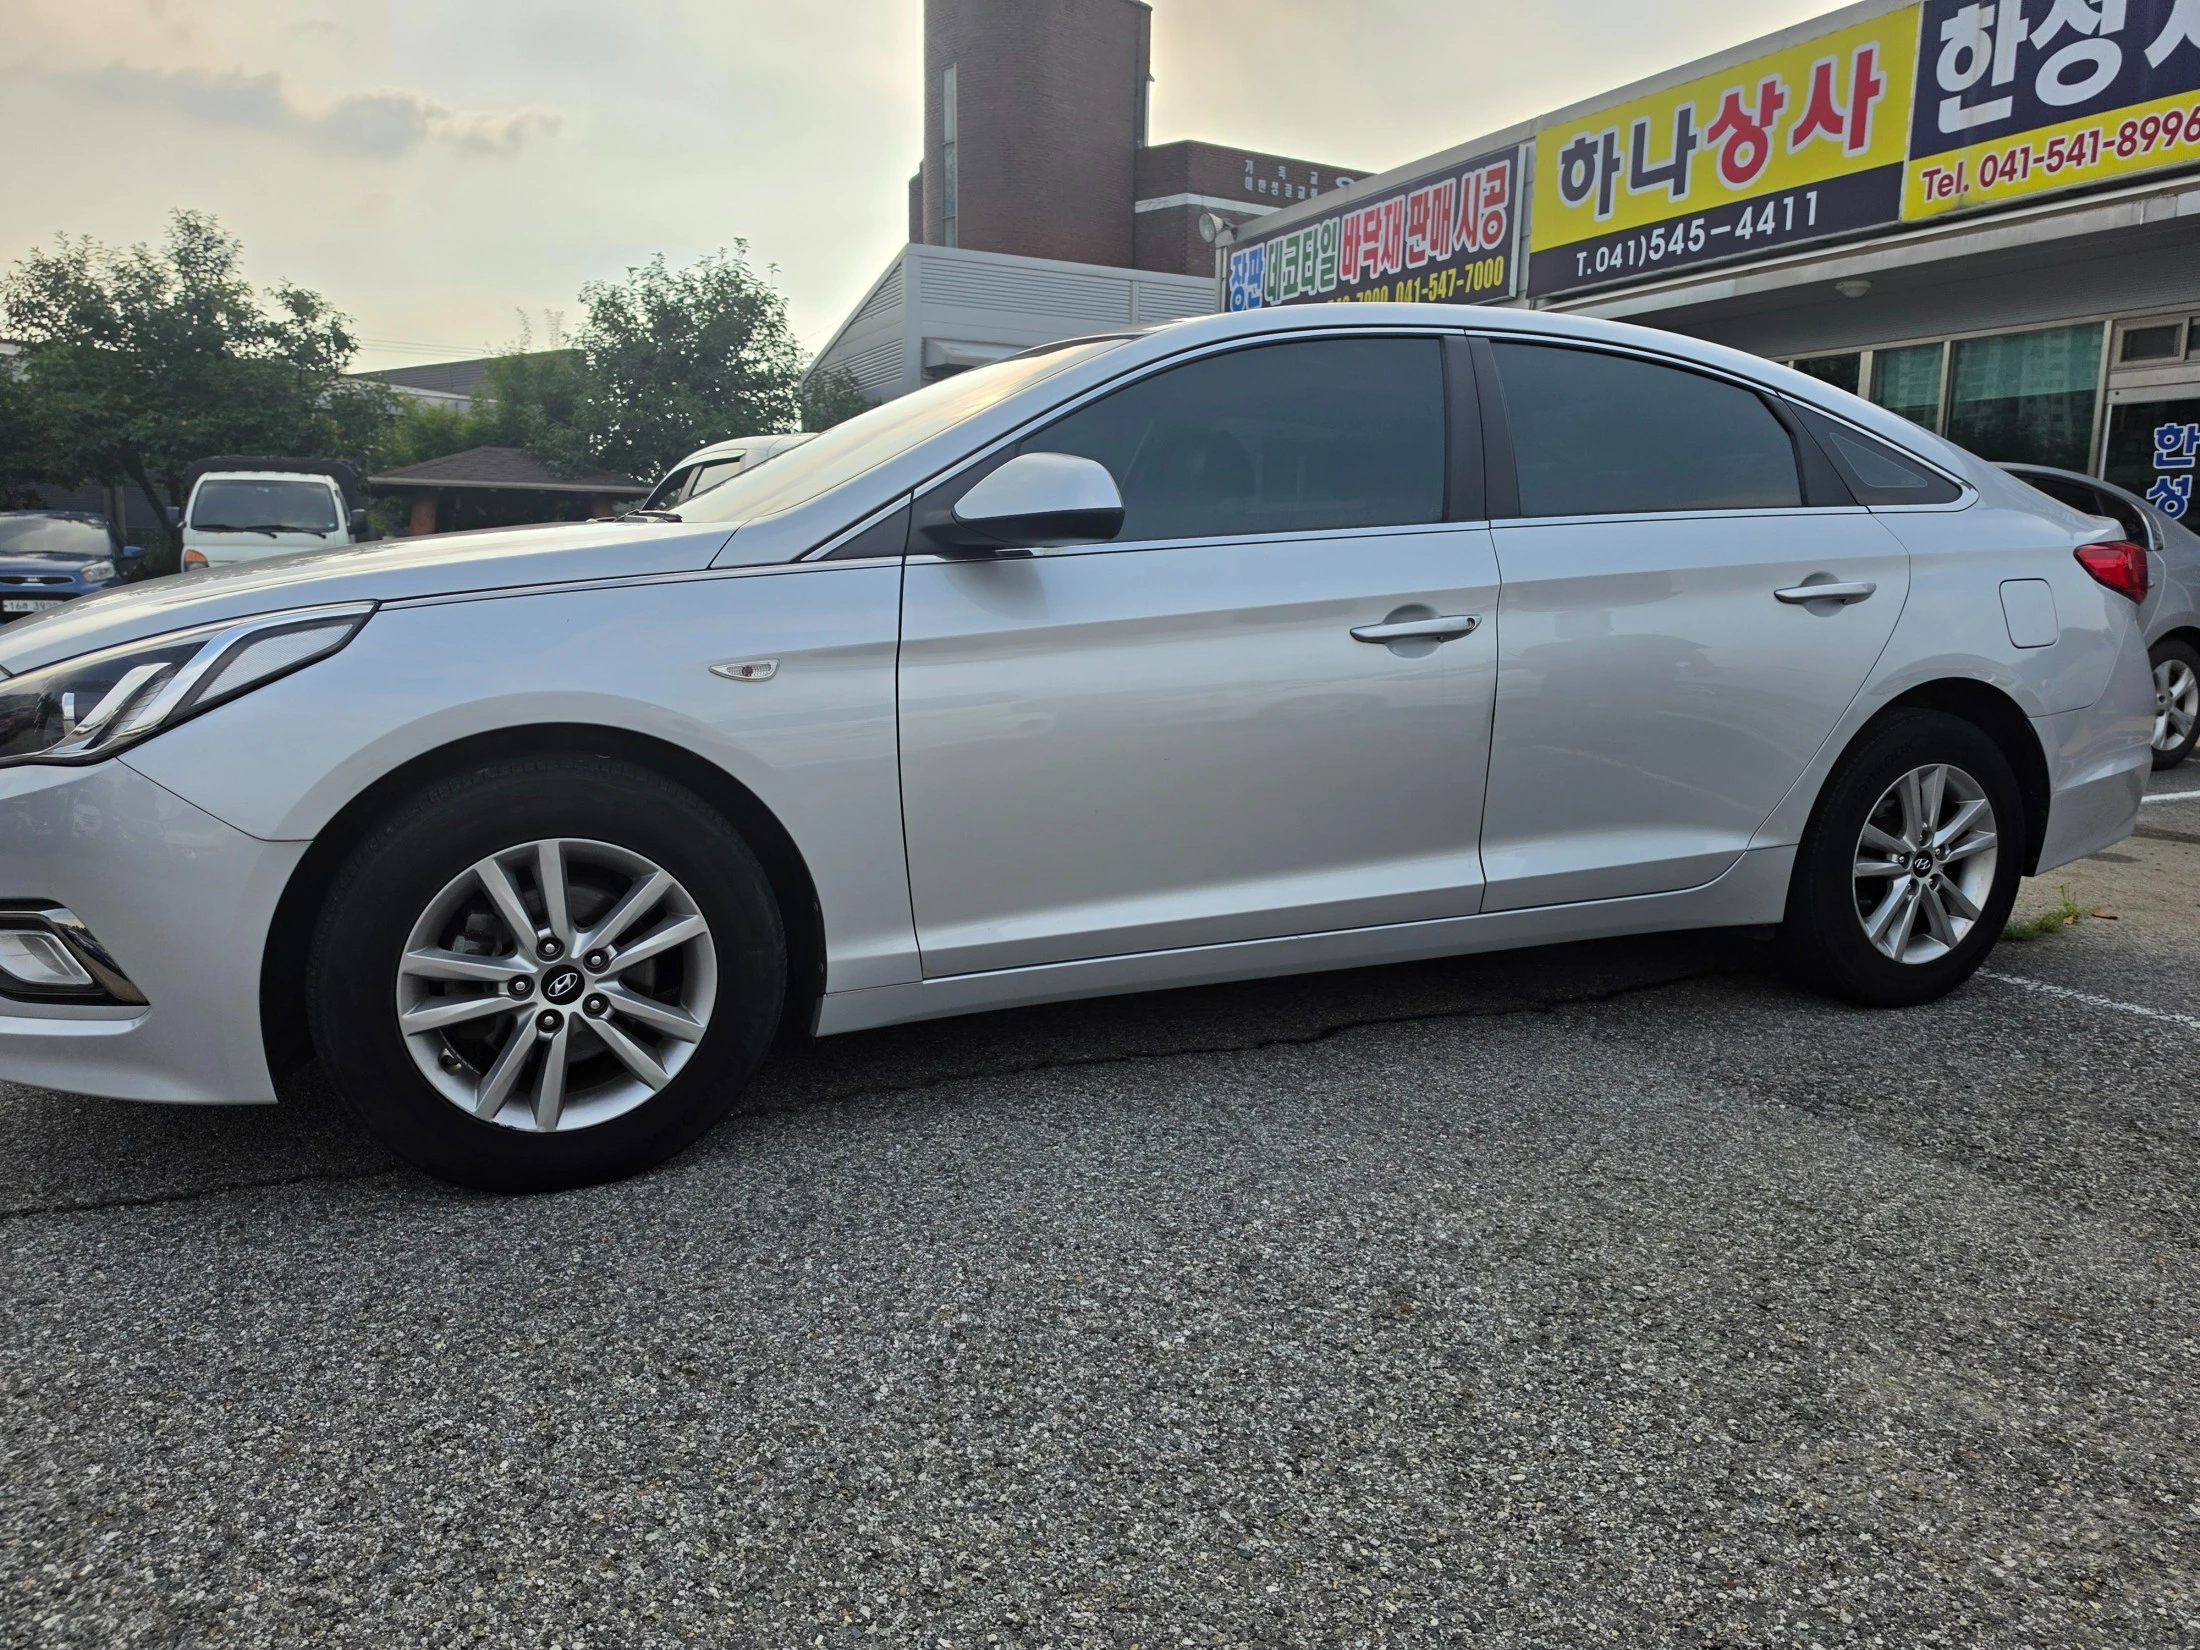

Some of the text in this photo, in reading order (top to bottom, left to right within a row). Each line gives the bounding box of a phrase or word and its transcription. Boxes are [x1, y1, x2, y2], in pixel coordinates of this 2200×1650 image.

[1558, 44, 1885, 220] 하나상사
[1922, 106, 2200, 201] Tel. 041-541-8996
[1230, 243, 1265, 312] 장판
[1265, 217, 1340, 306] 데코타일
[1340, 195, 1405, 284] 바닥재
[1395, 255, 1504, 303] 041-547-7000
